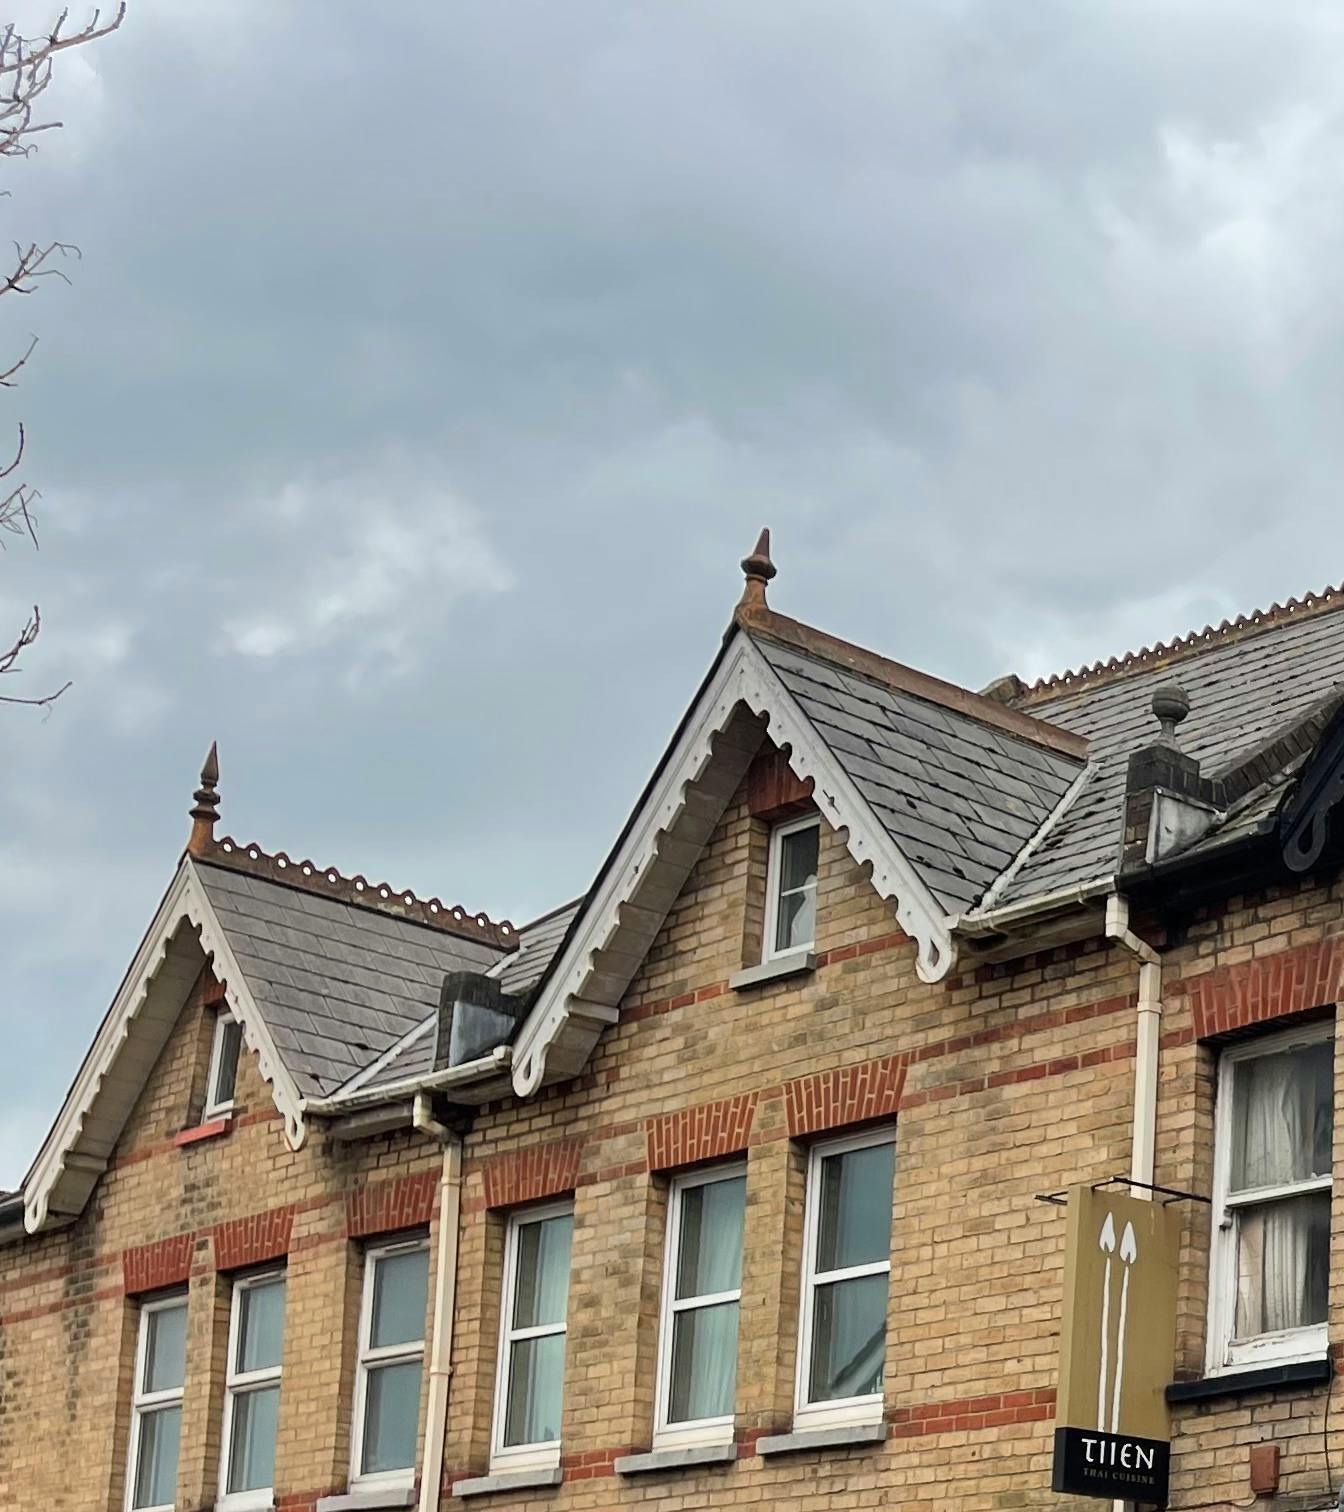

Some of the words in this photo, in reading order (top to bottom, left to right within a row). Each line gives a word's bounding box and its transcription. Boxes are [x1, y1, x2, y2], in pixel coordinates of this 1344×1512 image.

[1081, 1438, 1154, 1469] TIIEN
[1083, 1467, 1108, 1480] THAI
[1112, 1471, 1155, 1485] CUISINE
